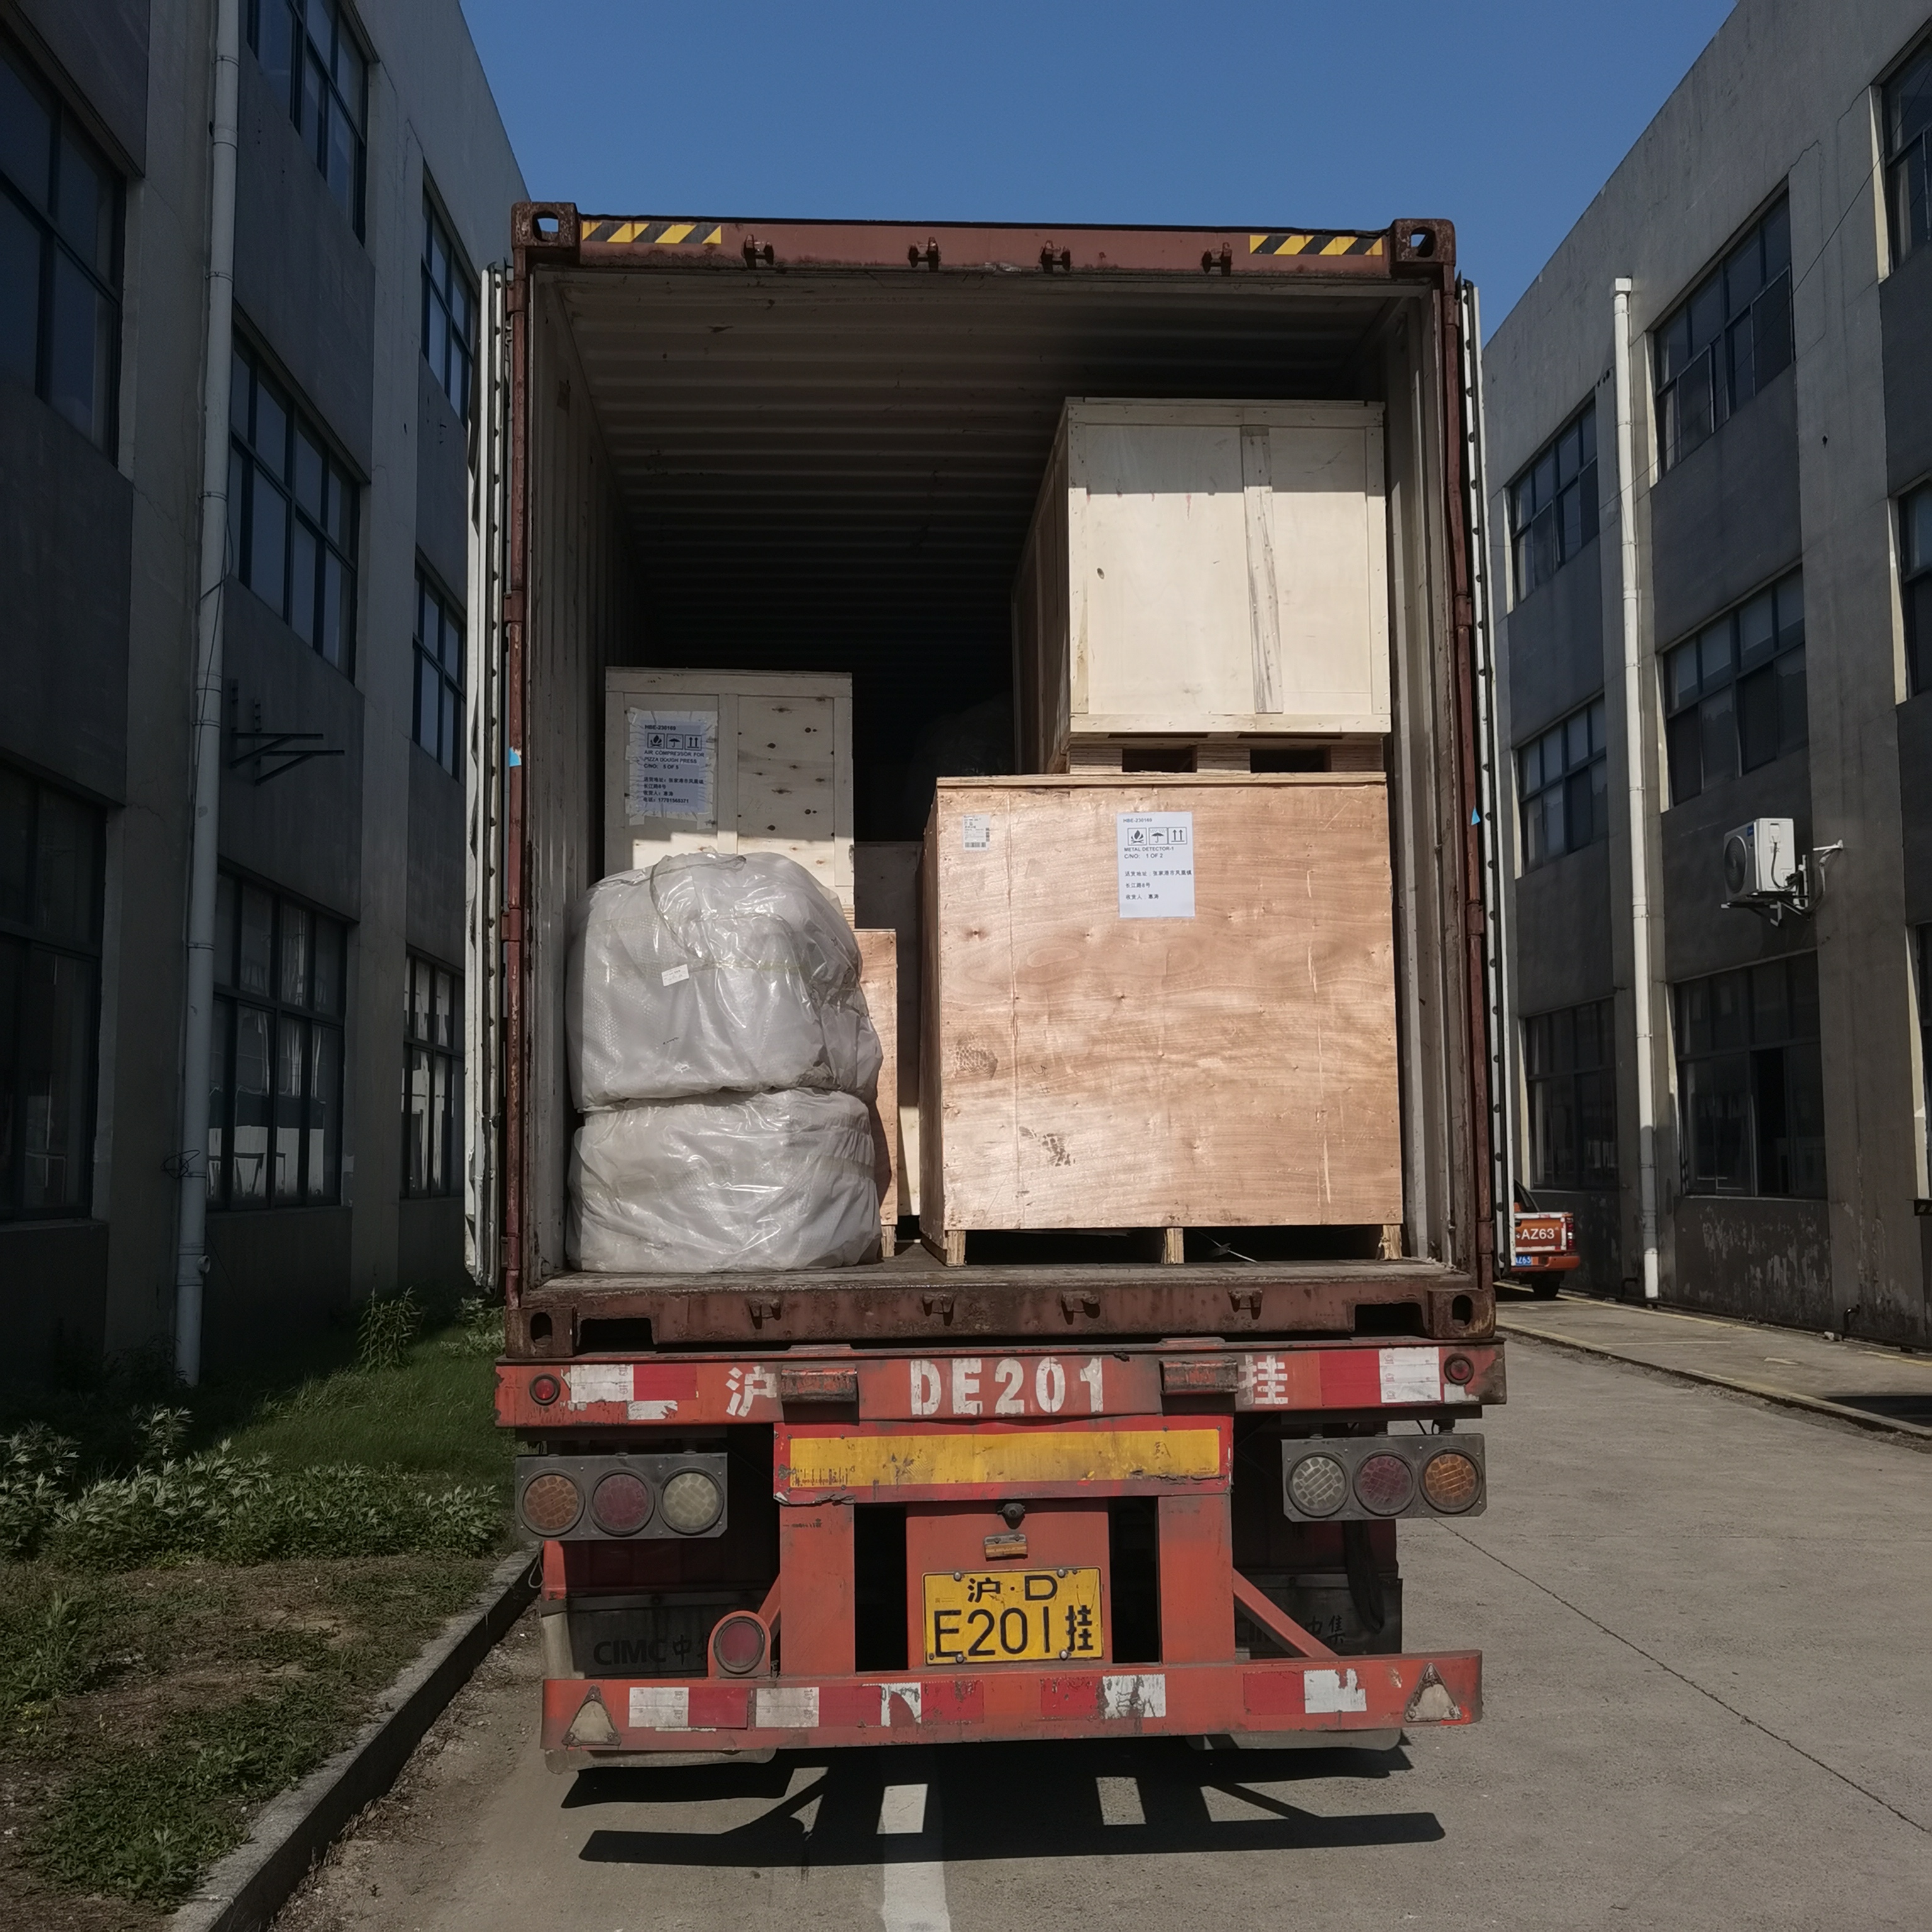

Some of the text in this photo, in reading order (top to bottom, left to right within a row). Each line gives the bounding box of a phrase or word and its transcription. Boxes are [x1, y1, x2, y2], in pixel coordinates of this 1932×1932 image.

[725, 1354, 1289, 1418] 沪 DE201 挂
[593, 1639, 667, 1665] CIMC
